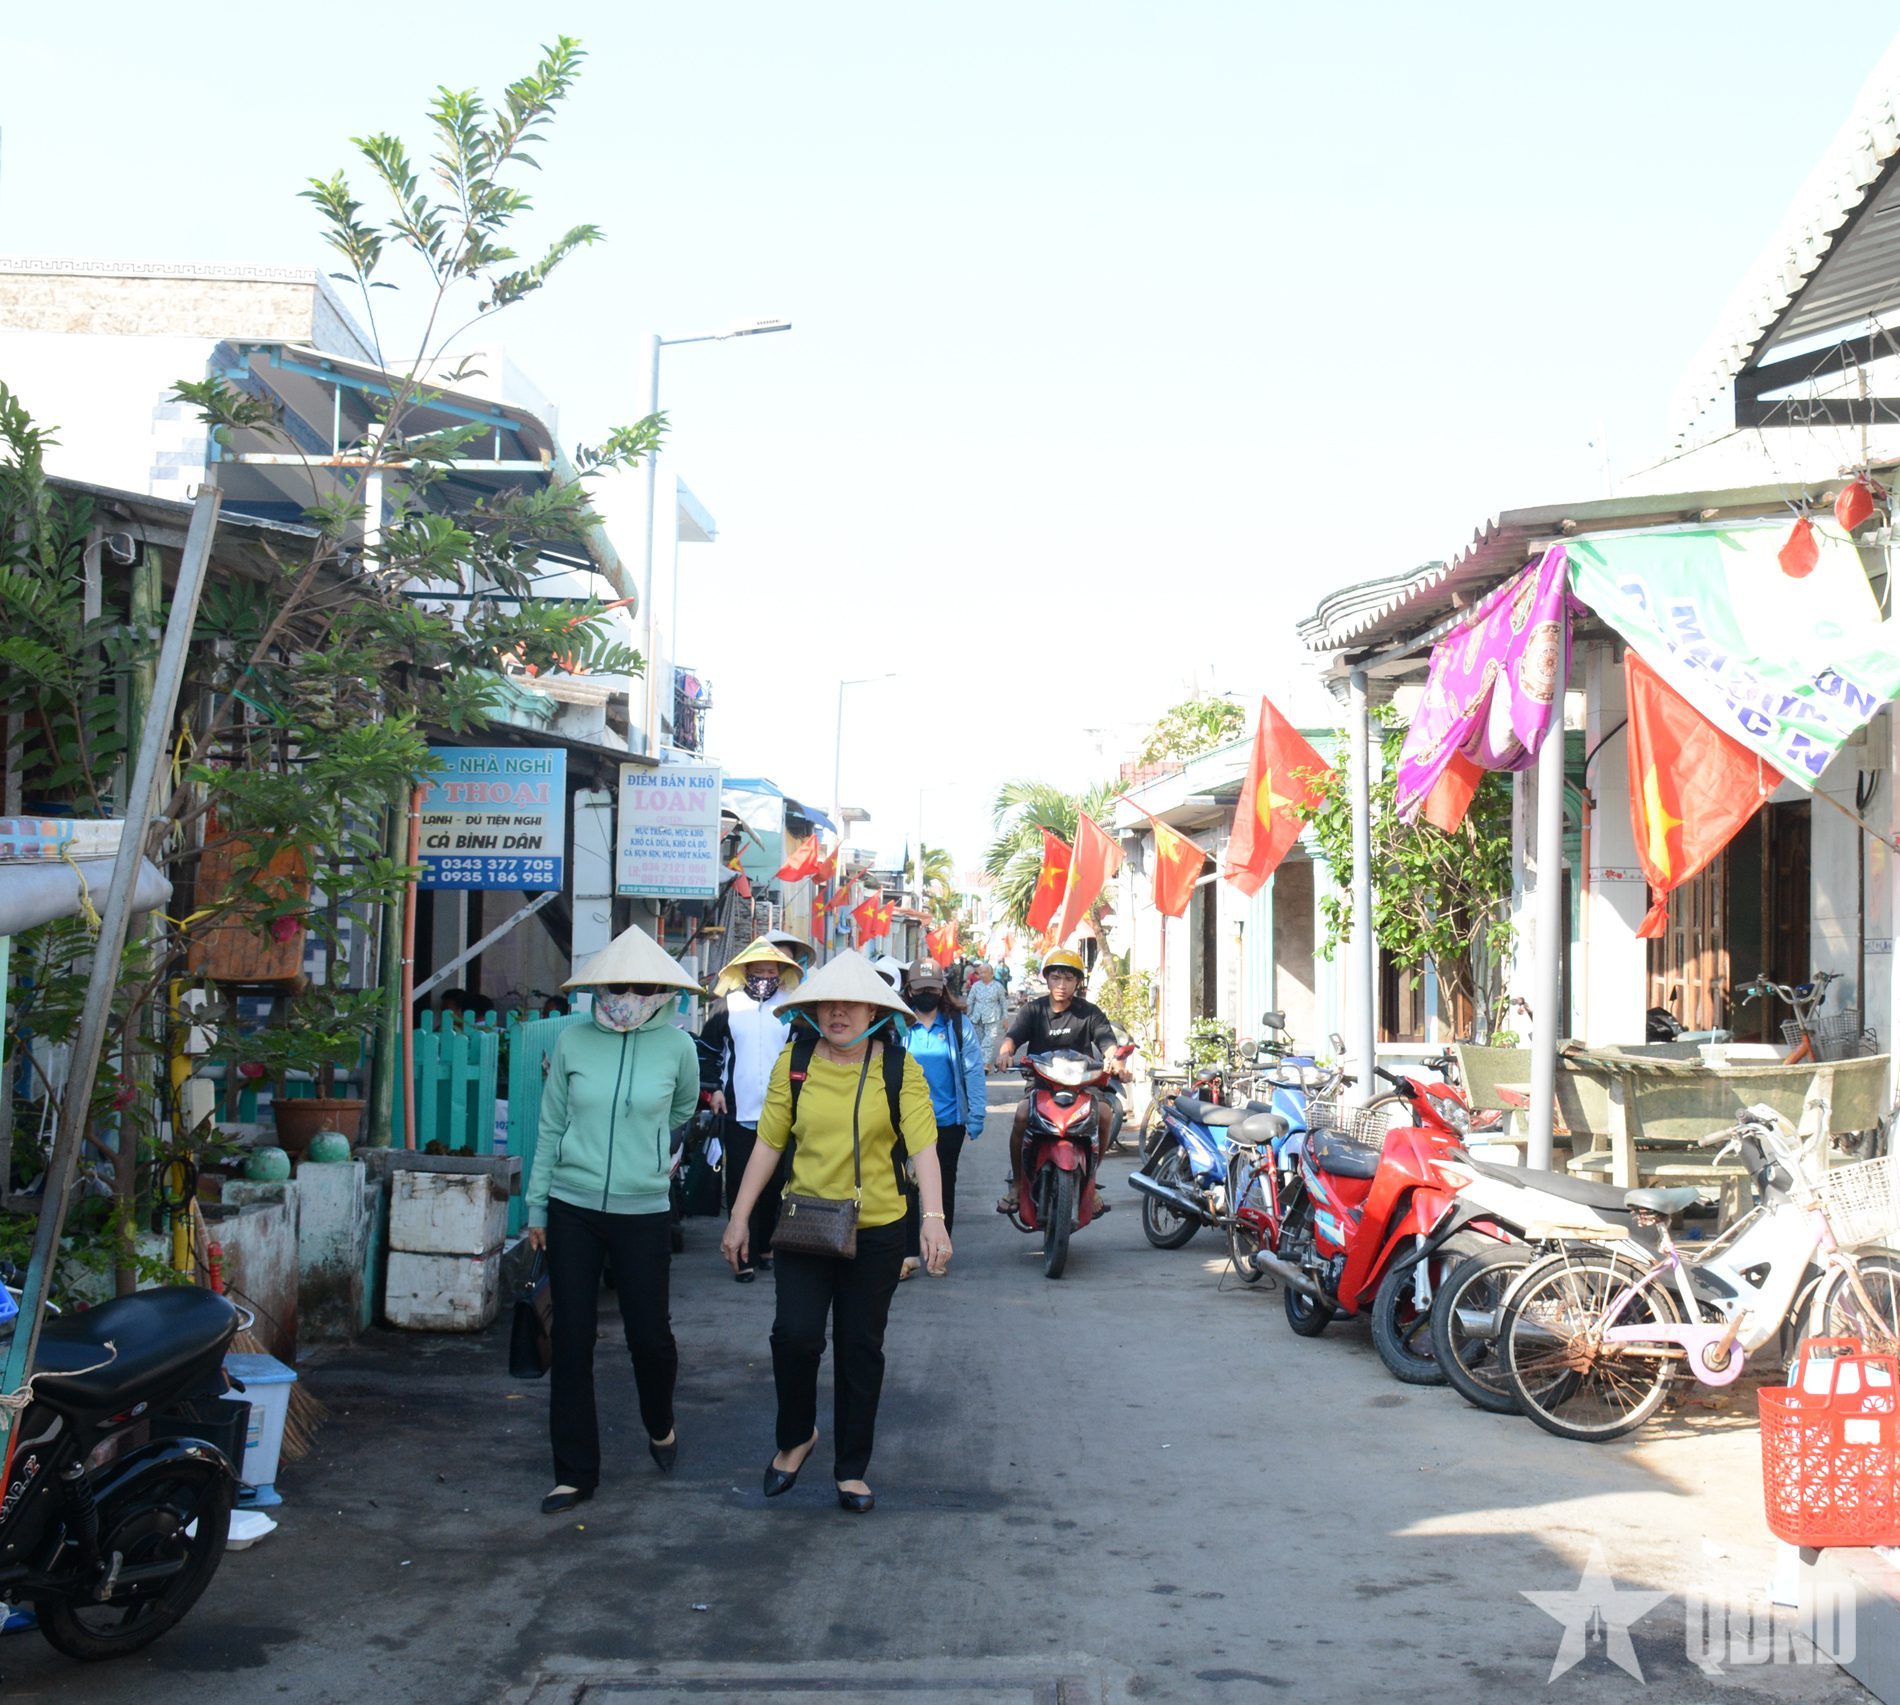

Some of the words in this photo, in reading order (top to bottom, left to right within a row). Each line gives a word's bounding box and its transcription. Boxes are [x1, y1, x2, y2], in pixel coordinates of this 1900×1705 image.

[459, 754, 499, 773] NHÀ
[505, 754, 553, 773] NGHỈ
[627, 769, 657, 786] ĐIỂM
[661, 773, 686, 787] BÁN
[689, 774, 714, 788] KHÔ
[442, 782, 551, 809] THOẠI
[634, 789, 707, 812] LOAN
[422, 815, 453, 826] LẠNH
[465, 813, 482, 825] ĐỦ
[487, 814, 510, 827] TIỆN
[513, 816, 542, 825] NGHI
[427, 831, 451, 848] CẢ
[455, 832, 498, 849] BÌNH
[502, 832, 543, 849] DÂN
[441, 859, 482, 870] 0343
[487, 859, 517, 870] 377
[523, 860, 553, 870] 705
[441, 871, 482, 882] 0935
[489, 872, 518, 882] 186
[522, 872, 553, 883] 955
